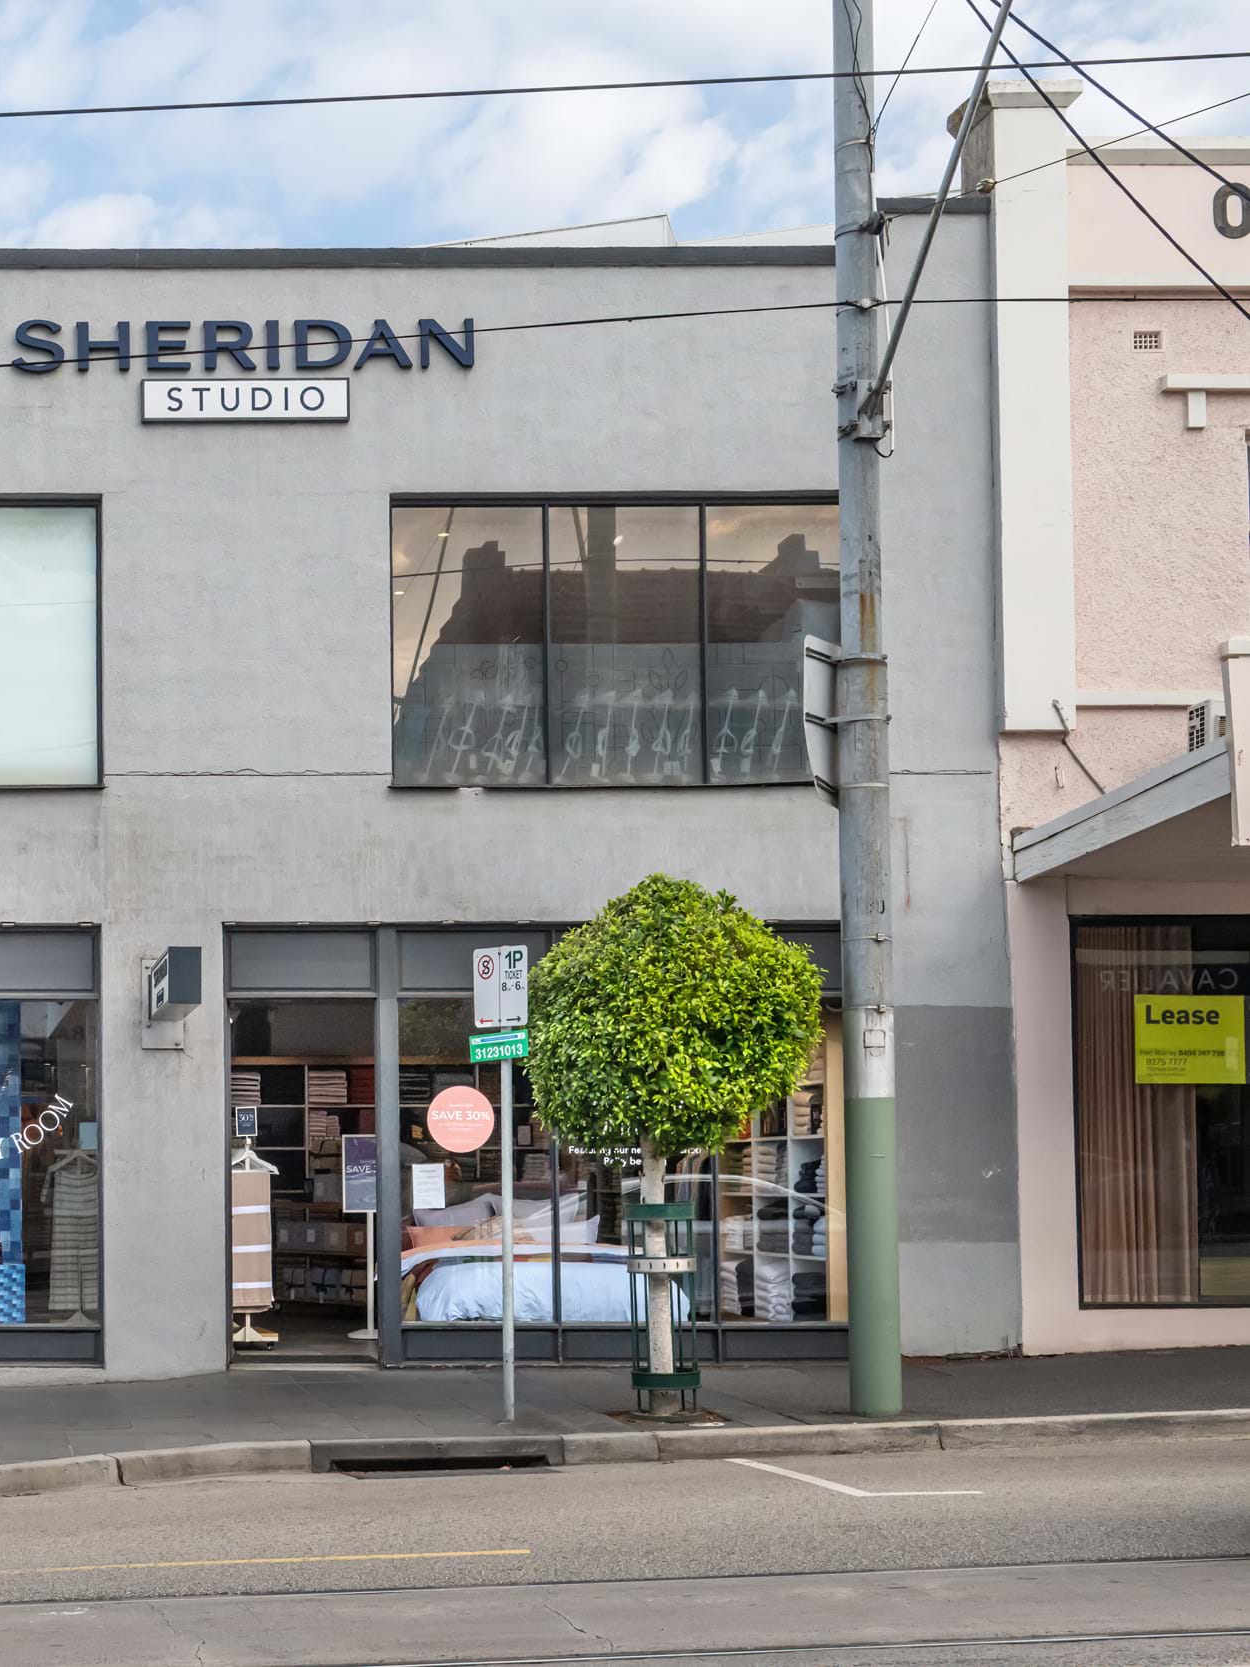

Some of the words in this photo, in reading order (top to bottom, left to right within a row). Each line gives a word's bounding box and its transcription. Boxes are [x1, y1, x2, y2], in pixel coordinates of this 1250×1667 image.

[12, 318, 474, 374] SHERIDAN
[167, 386, 326, 413] STUDIO
[505, 950, 523, 969] 1P
[504, 970, 523, 980] TICKET
[1145, 1004, 1220, 1025] Lease
[475, 1043, 523, 1060] 31231013
[10, 1093, 74, 1154] ROOM
[431, 1110, 462, 1120] SAVE
[465, 1110, 491, 1121] 30%
[346, 1165, 371, 1173] SAVE
